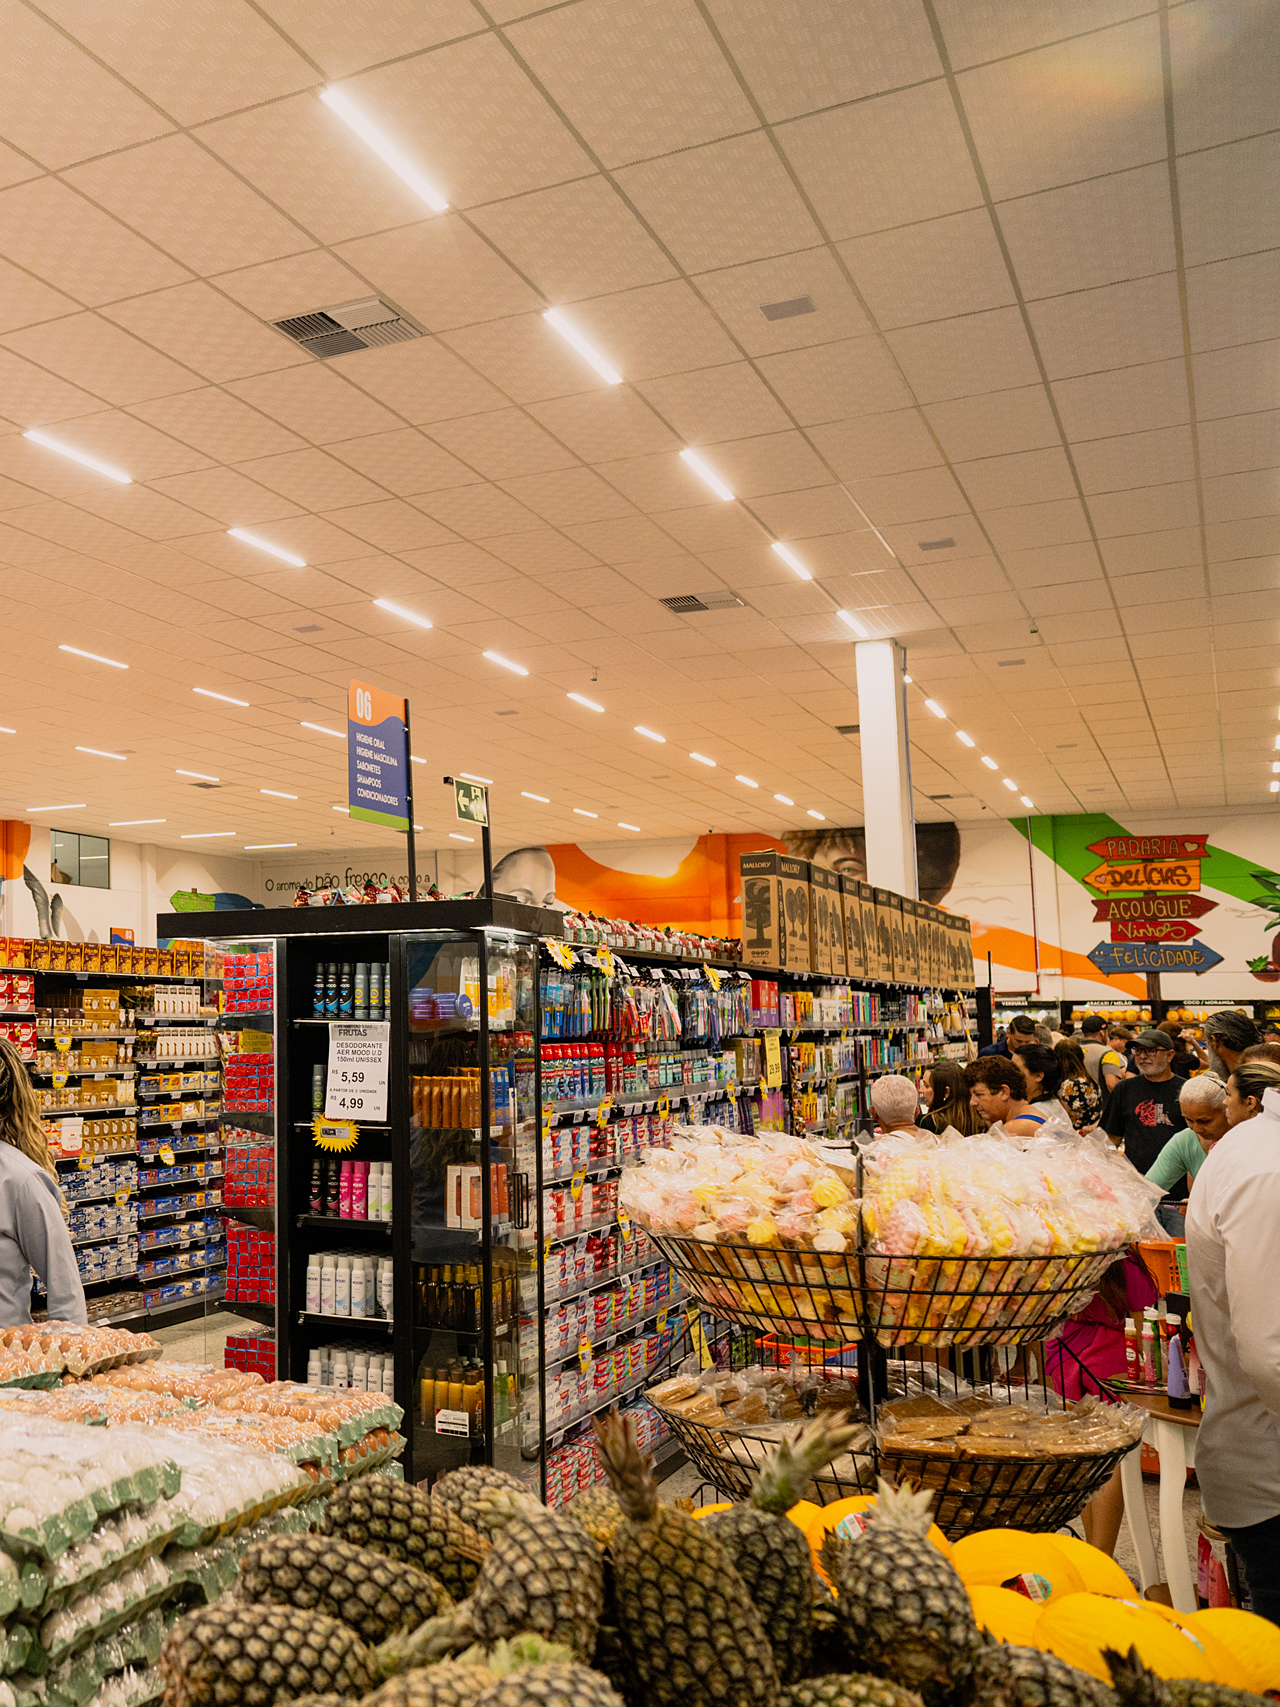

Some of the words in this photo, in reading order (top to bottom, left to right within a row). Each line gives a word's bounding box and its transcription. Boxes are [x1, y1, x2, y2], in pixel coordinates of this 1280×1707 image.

[356, 688, 372, 721] 06
[356, 732, 373, 747] HIGIENE
[373, 738, 385, 750] ORAL
[356, 746, 373, 759] HIGIENE
[373, 751, 398, 767] MASCULINA
[356, 760, 381, 775] SABONETES
[356, 774, 381, 789] SHAMPOOS
[356, 788, 398, 806] CONDICIONADORES
[1106, 838, 1180, 858] PADARIA
[742, 861, 771, 869] MALLORY
[781, 862, 800, 875] MALLORY
[277, 881, 301, 891] aroma
[398, 875, 421, 885] coo
[1106, 899, 1192, 920] AÇOUGUE
[1117, 922, 1187, 939] Vinhos
[341, 1072, 365, 1084] 5,59
[339, 1097, 364, 1110] 4,99
